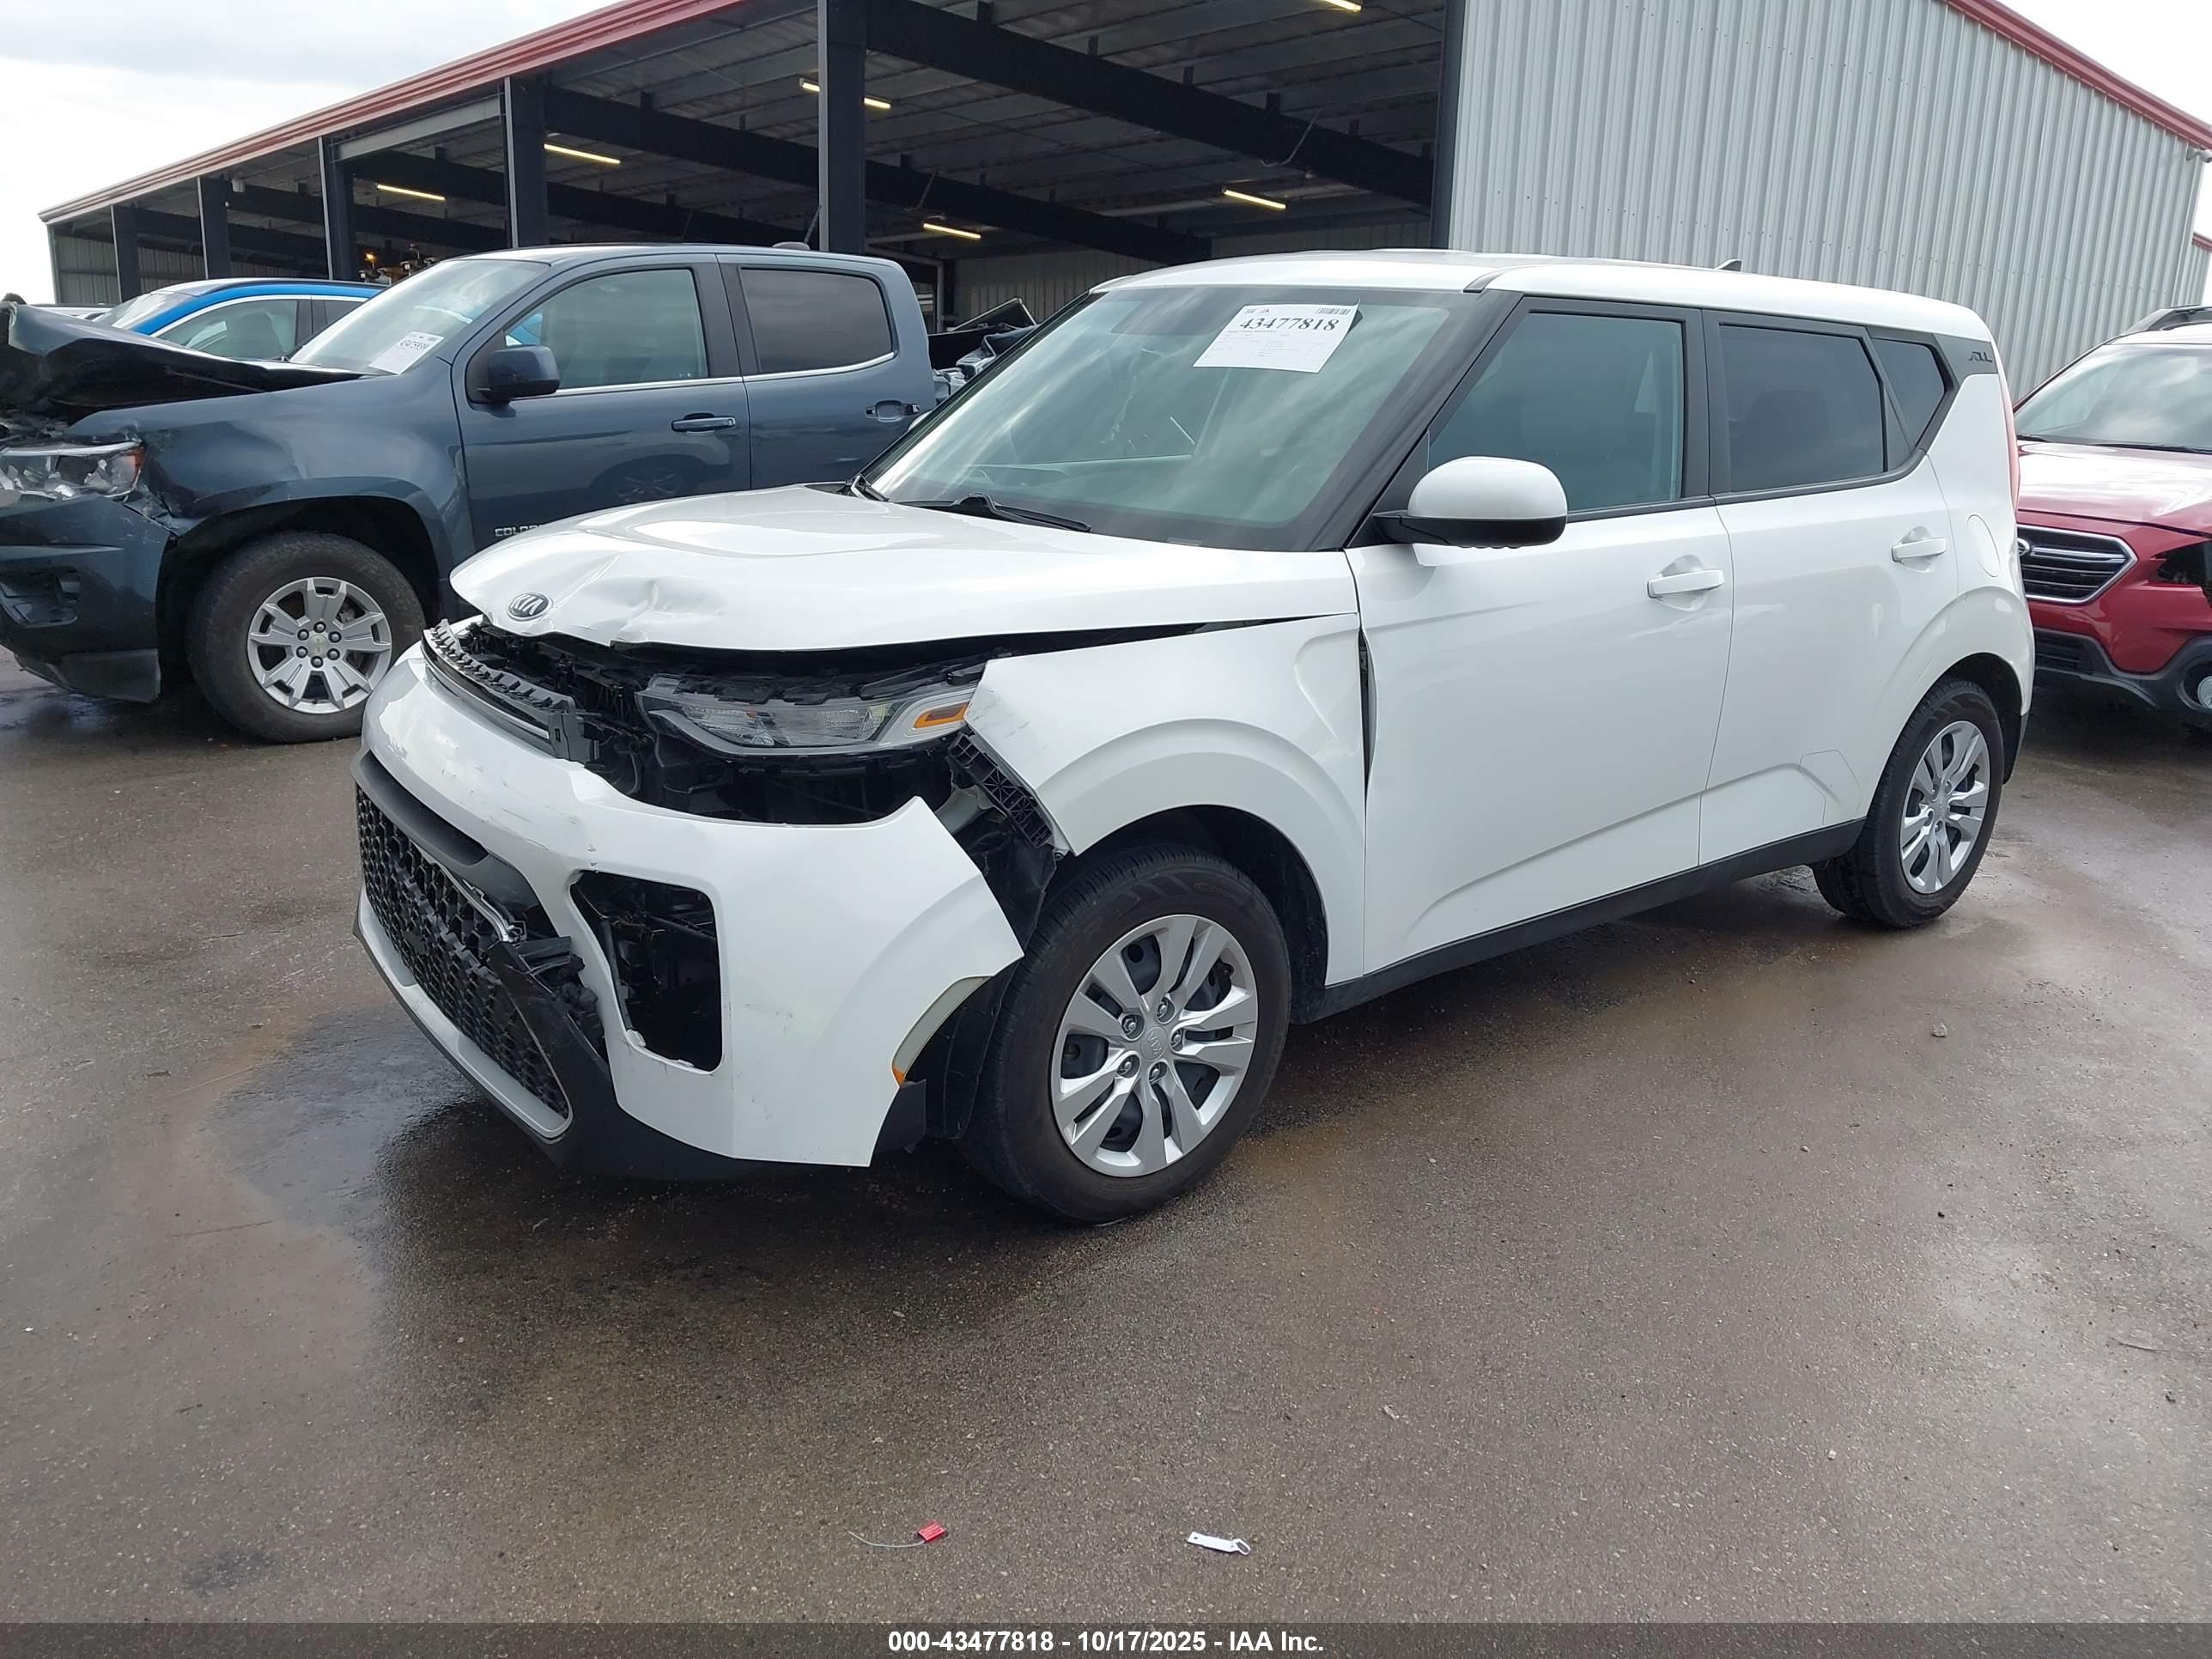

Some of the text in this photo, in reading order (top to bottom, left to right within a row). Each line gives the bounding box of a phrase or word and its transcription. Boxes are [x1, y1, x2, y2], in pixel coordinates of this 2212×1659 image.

[1239, 316, 1340, 331] 43477818
[495, 525, 540, 537] COLO
[510, 593, 544, 616] KIA
